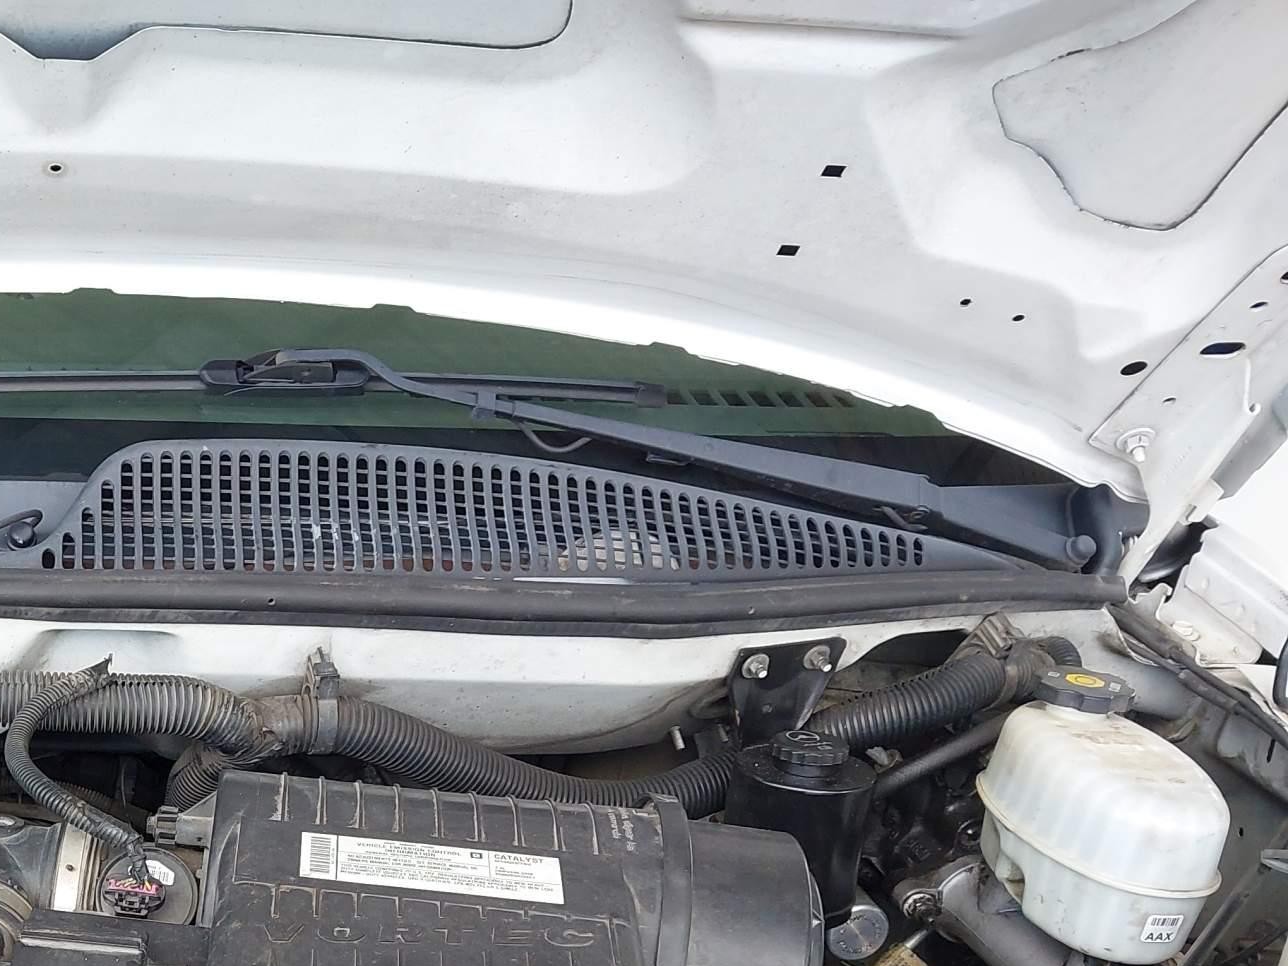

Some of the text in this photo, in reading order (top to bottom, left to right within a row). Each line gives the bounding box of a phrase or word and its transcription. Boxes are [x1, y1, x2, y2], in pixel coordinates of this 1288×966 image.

[494, 853, 544, 864] CATALYST
[263, 922, 596, 948] VORTEC
[1144, 932, 1174, 941] AAX
